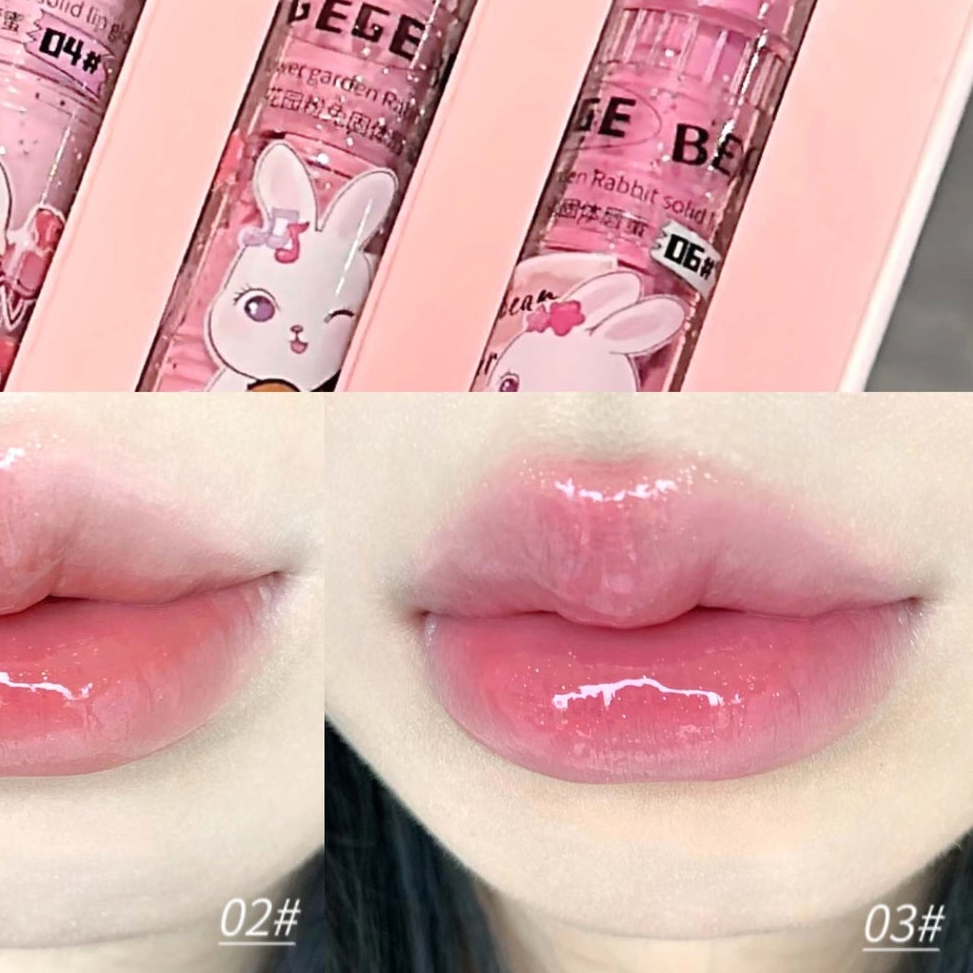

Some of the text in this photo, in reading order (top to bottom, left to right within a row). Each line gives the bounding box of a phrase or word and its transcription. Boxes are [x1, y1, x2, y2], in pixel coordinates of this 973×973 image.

[39, 28, 102, 74] 04#
[307, 68, 379, 102] garden
[591, 169, 659, 205] Rabbit
[663, 195, 707, 225] solid
[664, 233, 715, 280] 06#
